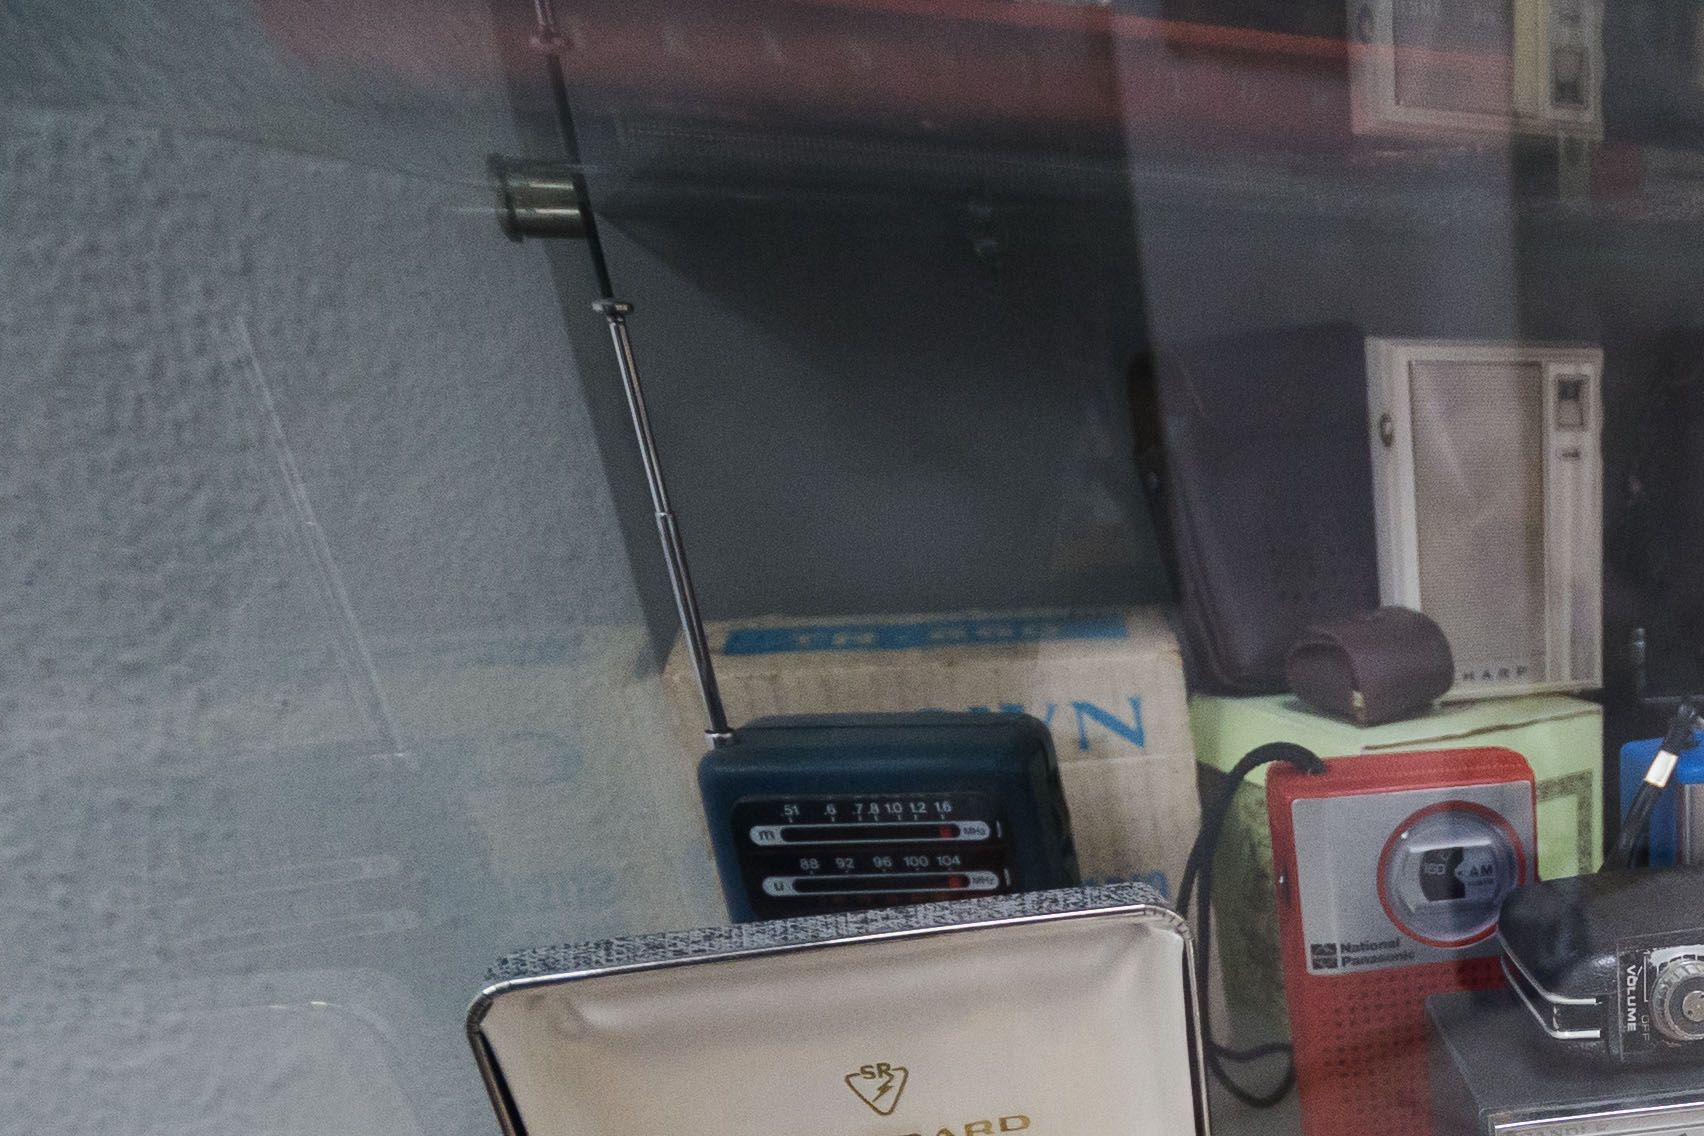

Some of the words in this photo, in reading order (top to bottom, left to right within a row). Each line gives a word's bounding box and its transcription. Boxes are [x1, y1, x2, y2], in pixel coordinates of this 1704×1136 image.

[1461, 663, 1528, 682] HARP
[800, 857, 820, 871] 88
[835, 857, 855, 870] 92
[873, 856, 893, 868] 96
[903, 855, 930, 868] 100
[936, 855, 962, 867] 104
[1470, 863, 1493, 877] AM
[1340, 937, 1402, 953] National
[1342, 951, 1417, 968] Panasonic
[1626, 964, 1638, 1032] VOLUME
[1641, 1014, 1650, 1041] OFF
[859, 1062, 892, 1081] SR
